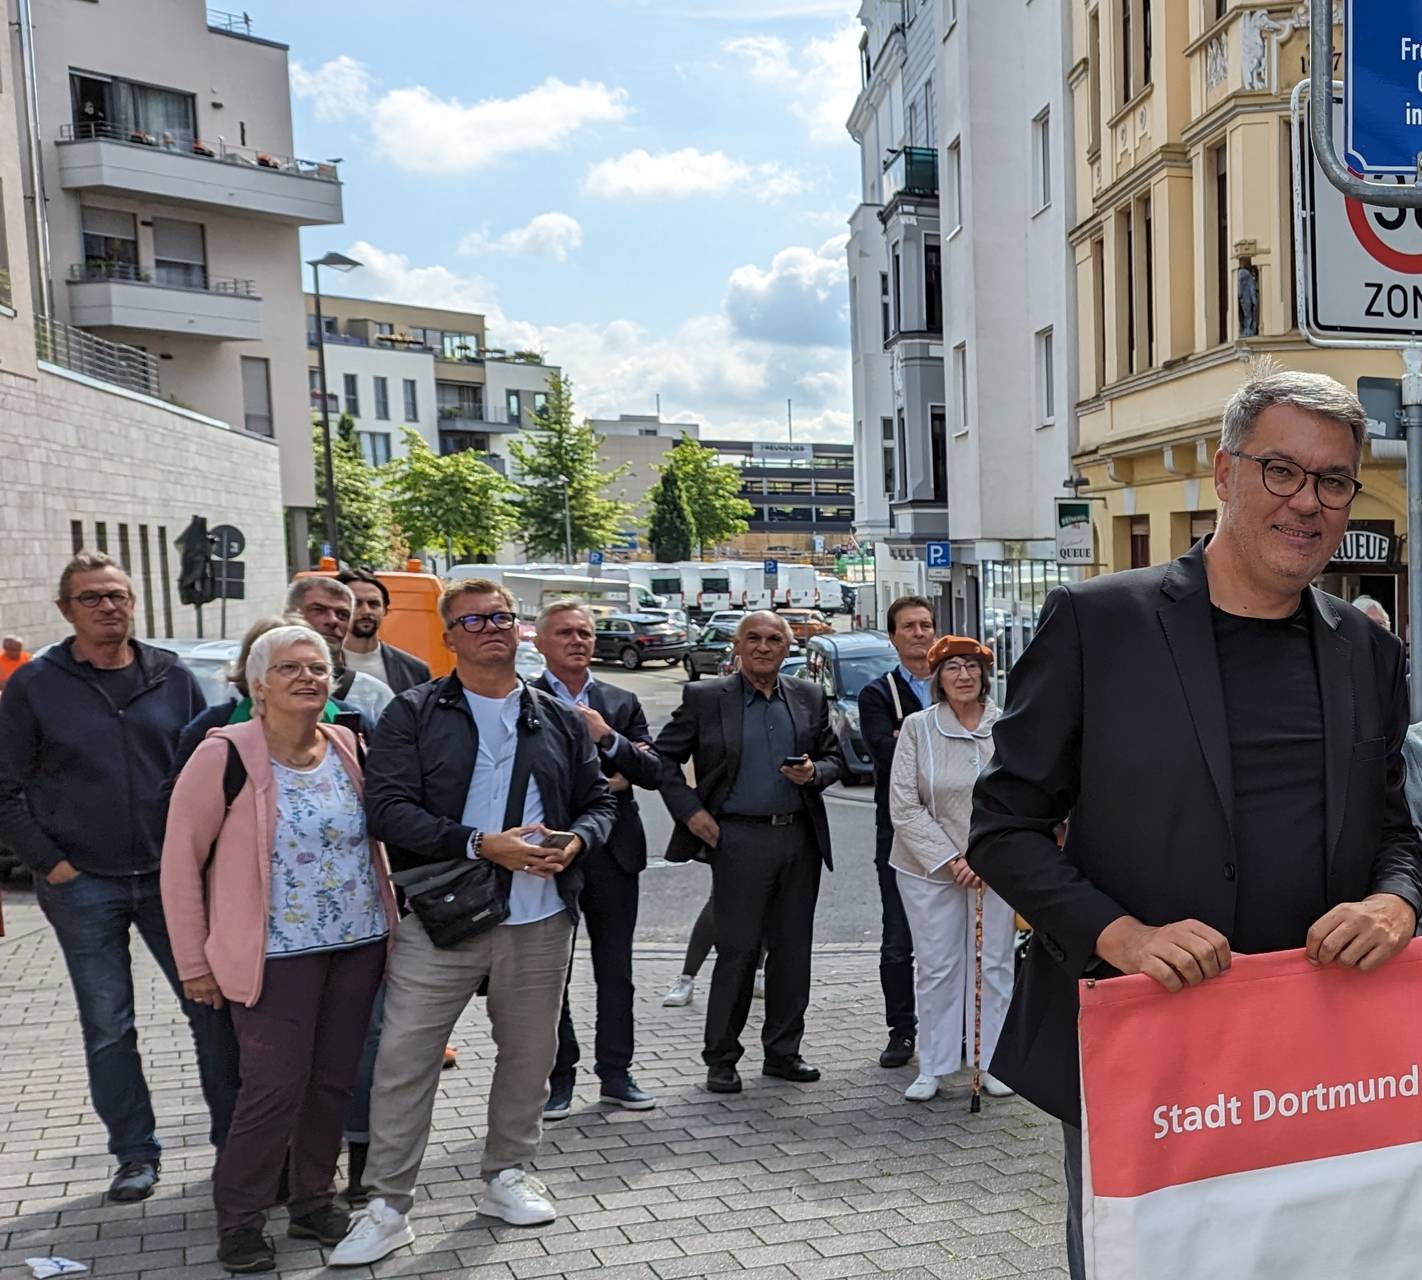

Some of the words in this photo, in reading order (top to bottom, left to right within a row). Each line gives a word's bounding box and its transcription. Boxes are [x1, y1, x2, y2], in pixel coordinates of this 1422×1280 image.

[930, 545, 944, 565] P
[1060, 548, 1091, 559] QUEUE
[1153, 1093, 1242, 1140] Stadt
[1252, 1064, 1419, 1122] Dortmund
